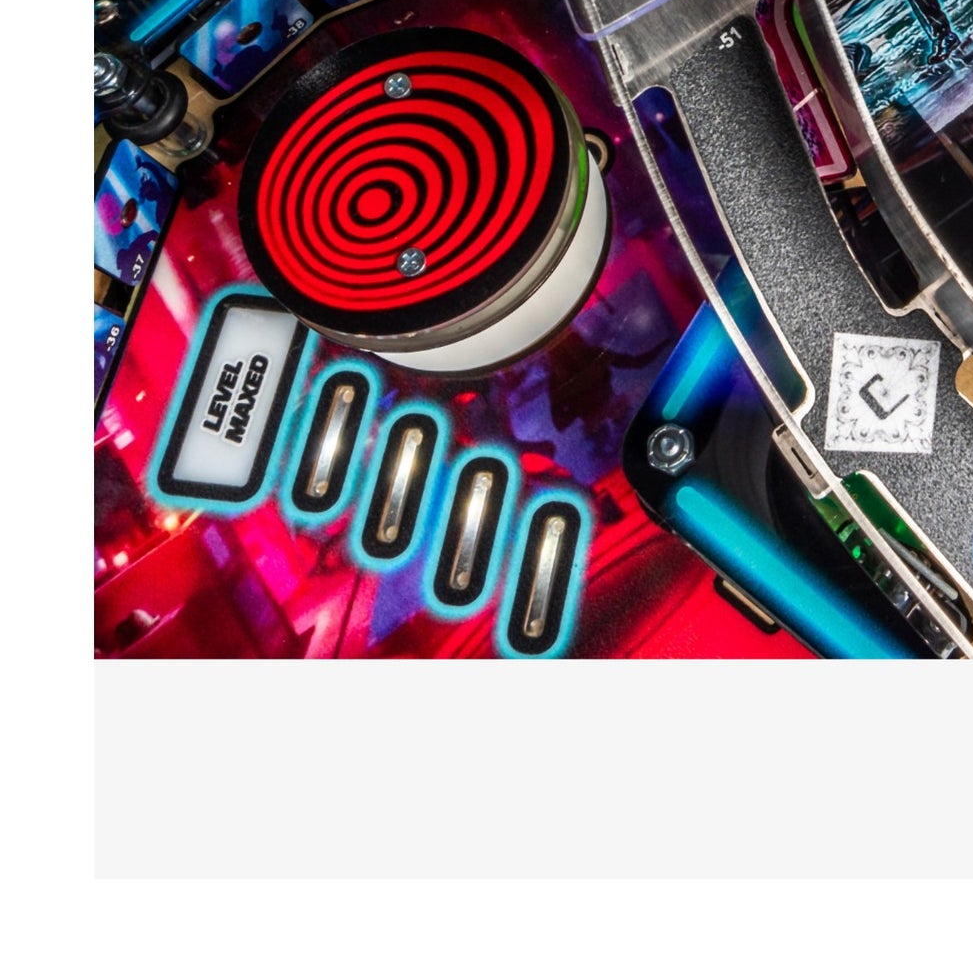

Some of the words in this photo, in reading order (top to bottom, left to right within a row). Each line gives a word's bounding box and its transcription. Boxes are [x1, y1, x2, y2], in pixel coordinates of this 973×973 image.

[286, 19, 306, 38] -38
[718, 26, 742, 51] -51
[132, 253, 144, 279] -37
[106, 325, 120, 352] -36
[202, 360, 244, 434] LEVEL
[224, 353, 269, 444] MAXED
